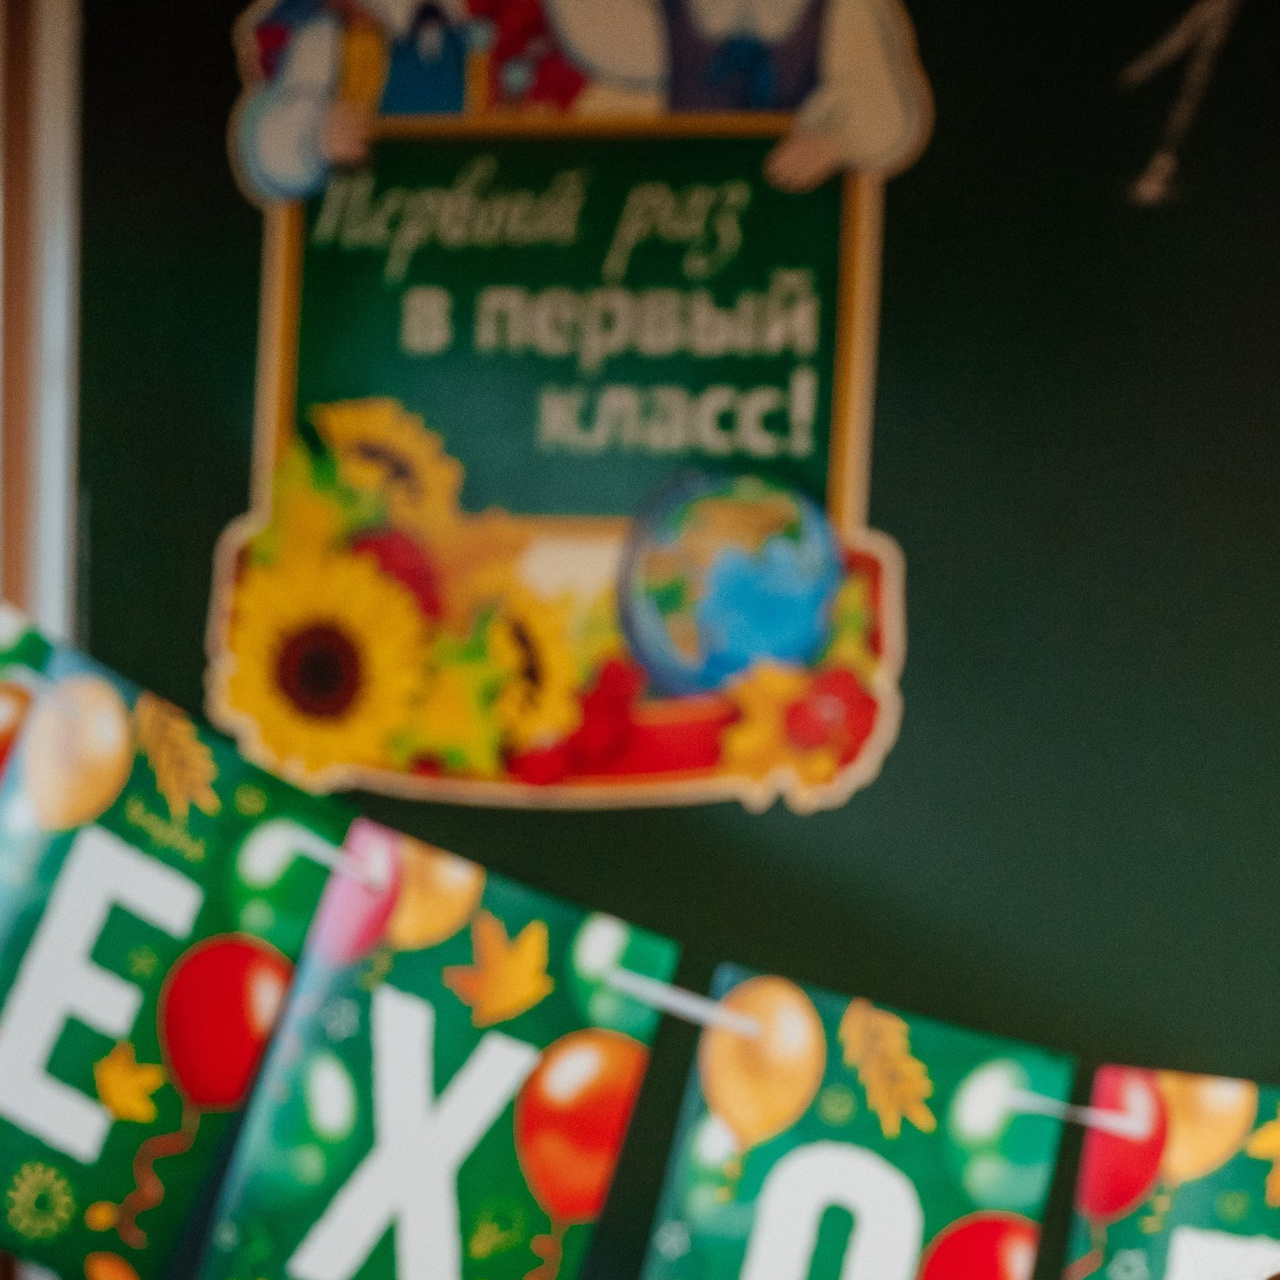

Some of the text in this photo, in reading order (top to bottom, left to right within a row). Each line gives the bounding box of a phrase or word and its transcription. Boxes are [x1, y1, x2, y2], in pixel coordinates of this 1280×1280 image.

[1118, 0, 1240, 205] 1
[602, 179, 751, 282] раз
[402, 267, 820, 376] в первый
[538, 364, 820, 459] класс!
